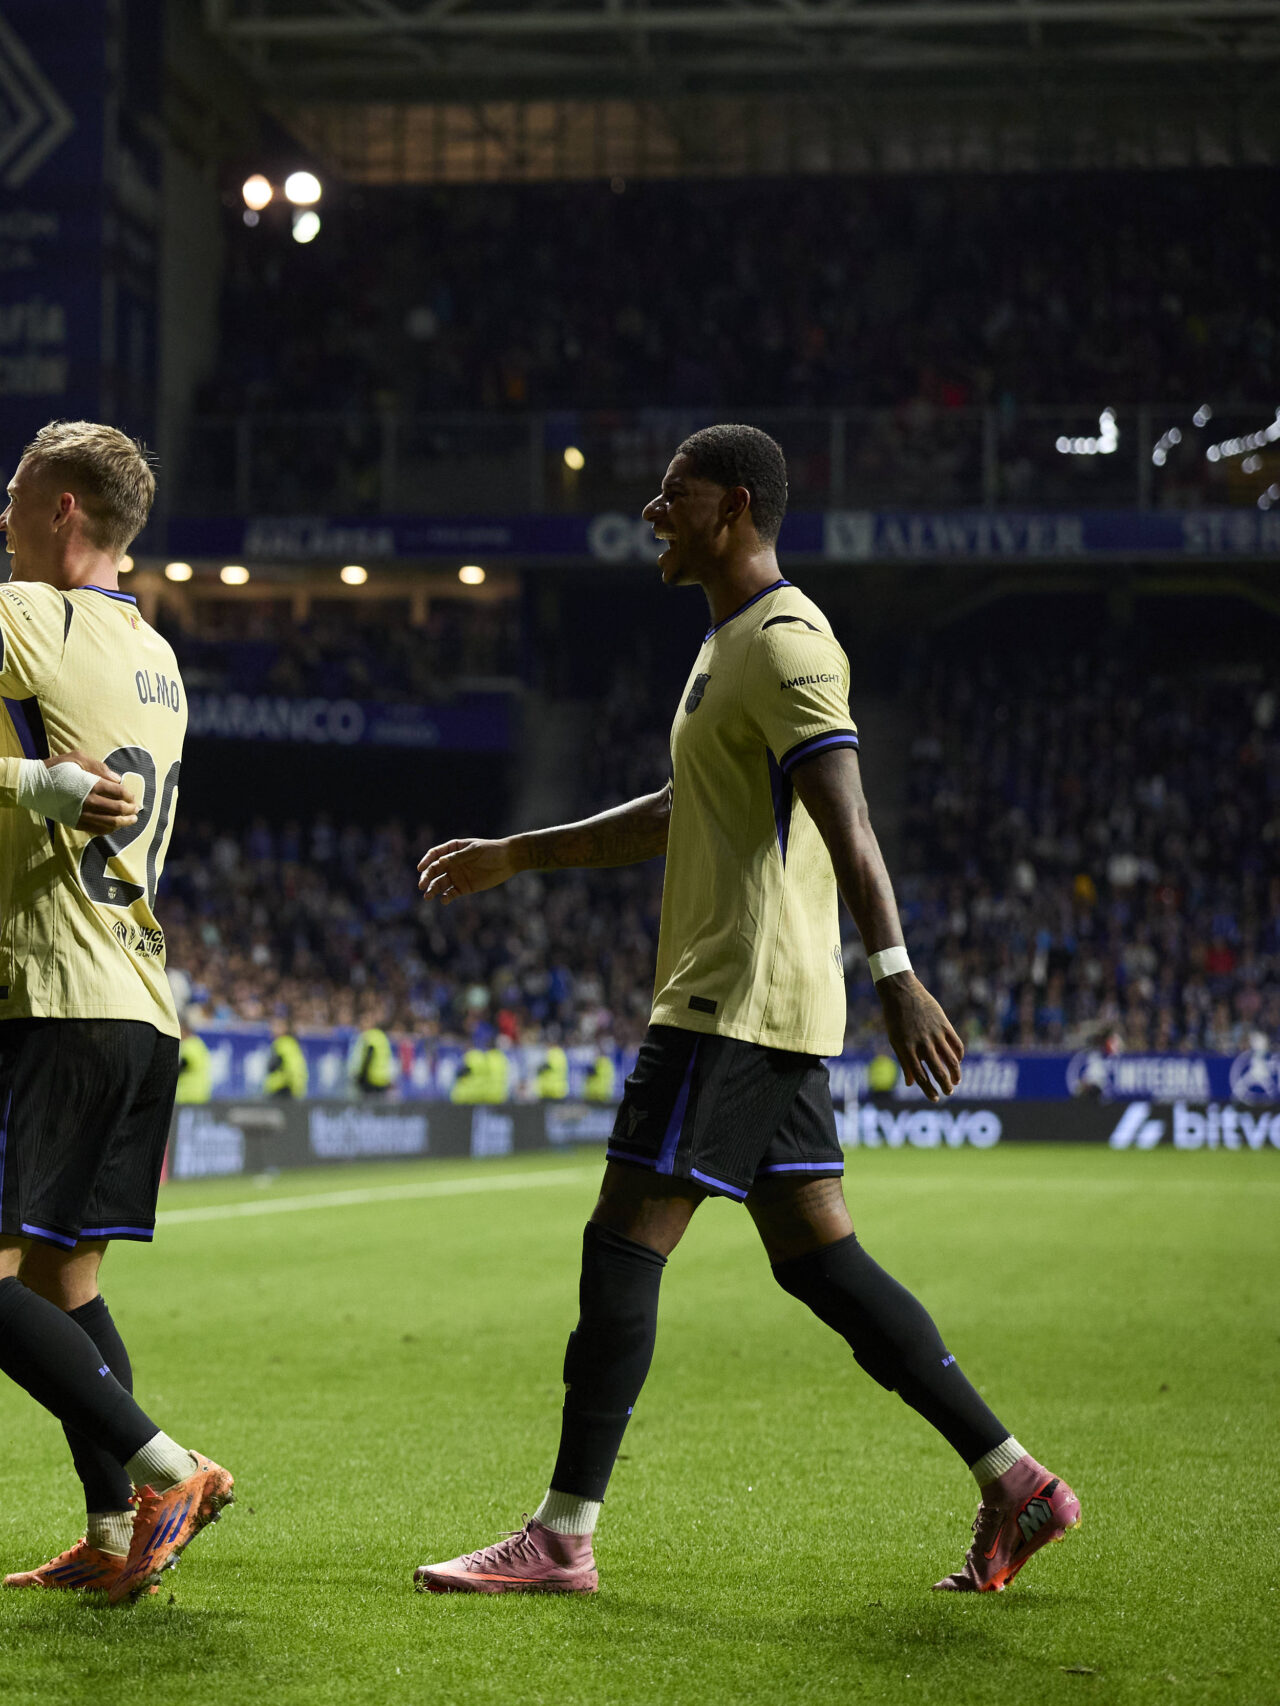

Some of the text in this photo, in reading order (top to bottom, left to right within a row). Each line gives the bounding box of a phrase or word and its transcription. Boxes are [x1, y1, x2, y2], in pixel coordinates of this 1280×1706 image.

[135, 669, 180, 713] OLMO
[780, 673, 840, 691] AMBILIGHT
[1172, 1100, 1280, 1150] bitv
